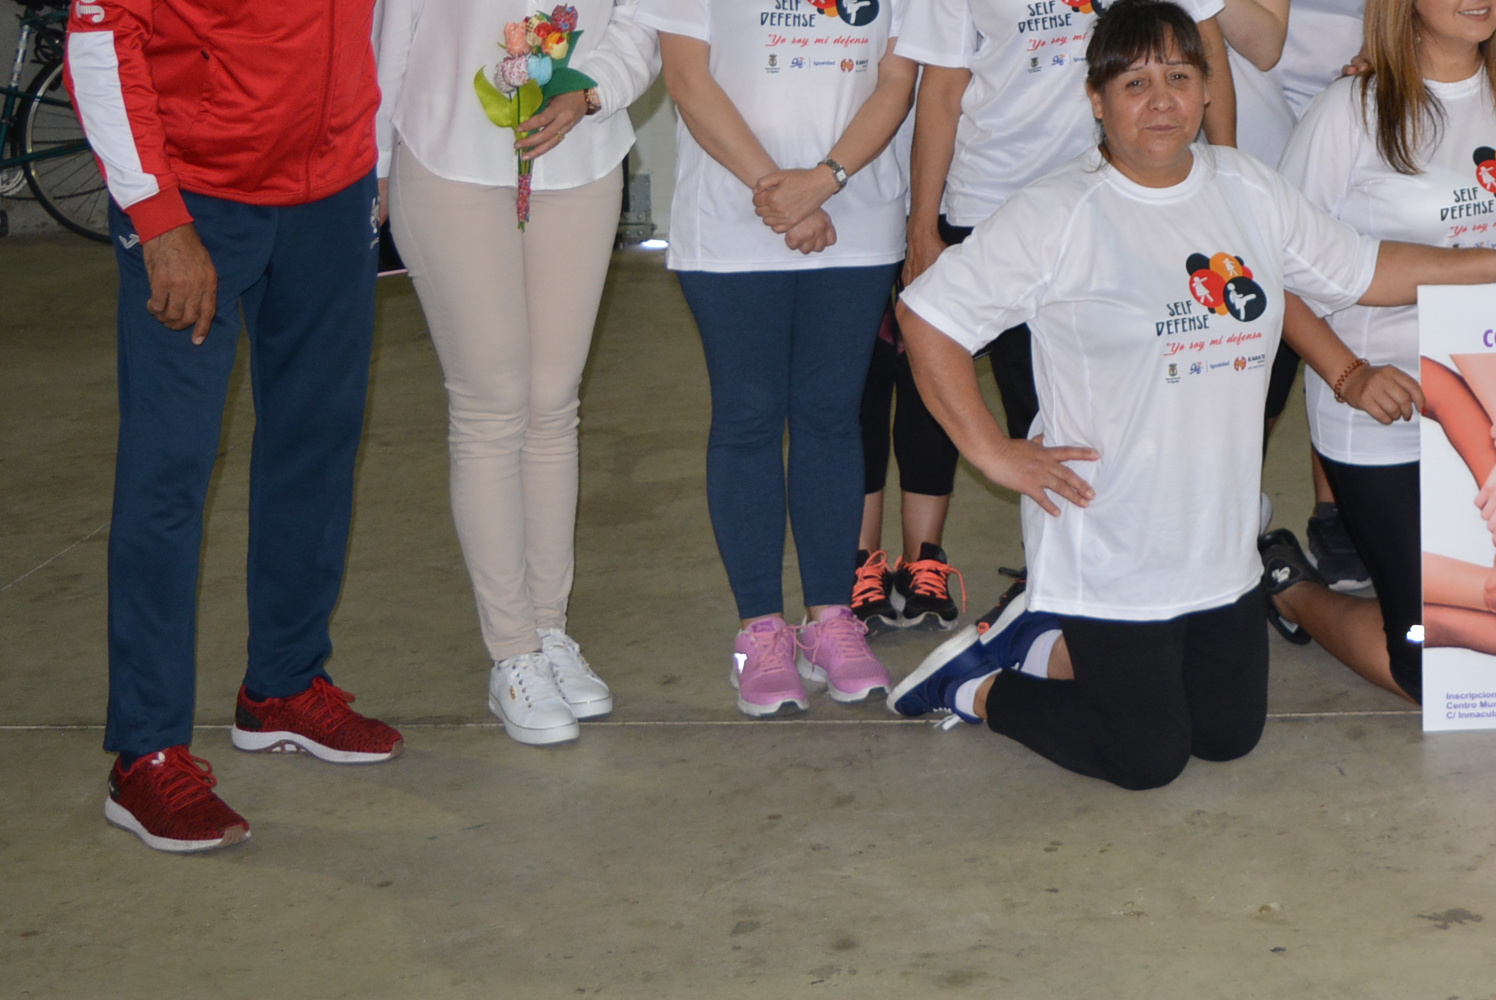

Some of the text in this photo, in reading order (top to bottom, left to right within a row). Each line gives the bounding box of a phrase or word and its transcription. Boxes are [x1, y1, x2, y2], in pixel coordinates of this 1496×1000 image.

[1027, 0, 1056, 17] SELF
[760, 12, 817, 28] DEFENSE
[1018, 13, 1072, 33] DEFENSE
[791, 36, 809, 47] soy
[814, 36, 830, 45] mi
[833, 35, 869, 47] defensa
[1051, 36, 1067, 46] soy
[1453, 186, 1478, 203] SELF
[1440, 199, 1495, 222] DEFENSE
[1472, 223, 1488, 234] soy
[1166, 300, 1192, 317] SELF
[1155, 314, 1210, 337] DEFENSE
[1189, 340, 1205, 352] soy
[1210, 335, 1224, 346] mi
[1226, 331, 1263, 345] defensa
[1446, 701, 1477, 710] Centro
[1446, 710, 1456, 719] C/
